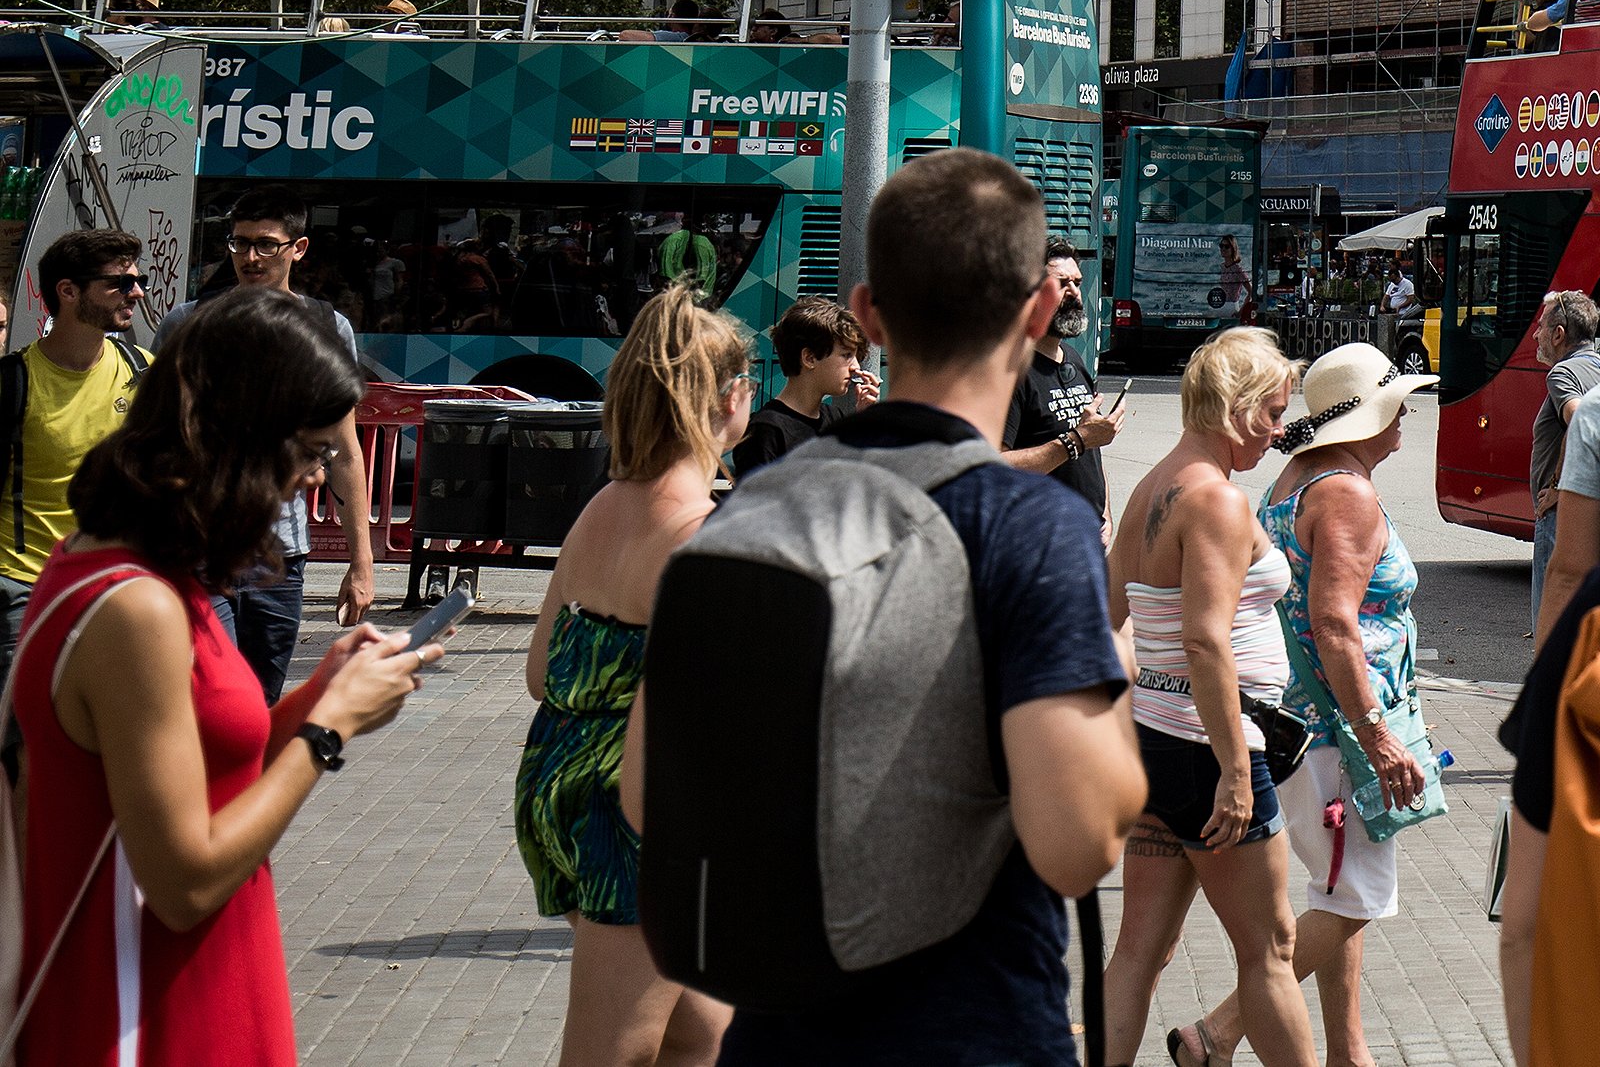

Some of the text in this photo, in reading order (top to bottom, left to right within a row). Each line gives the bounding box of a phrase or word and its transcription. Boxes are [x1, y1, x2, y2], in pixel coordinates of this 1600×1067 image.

[1013, 18, 1052, 43] Barcelona
[1104, 65, 1159, 88] olivia plaza
[1079, 83, 1099, 105] 2336
[1150, 150, 1197, 161] Barcelona
[1230, 170, 1252, 181] 2155
[1468, 205, 1498, 230] 2543
[1141, 237, 1214, 249] Diagonal Mar
